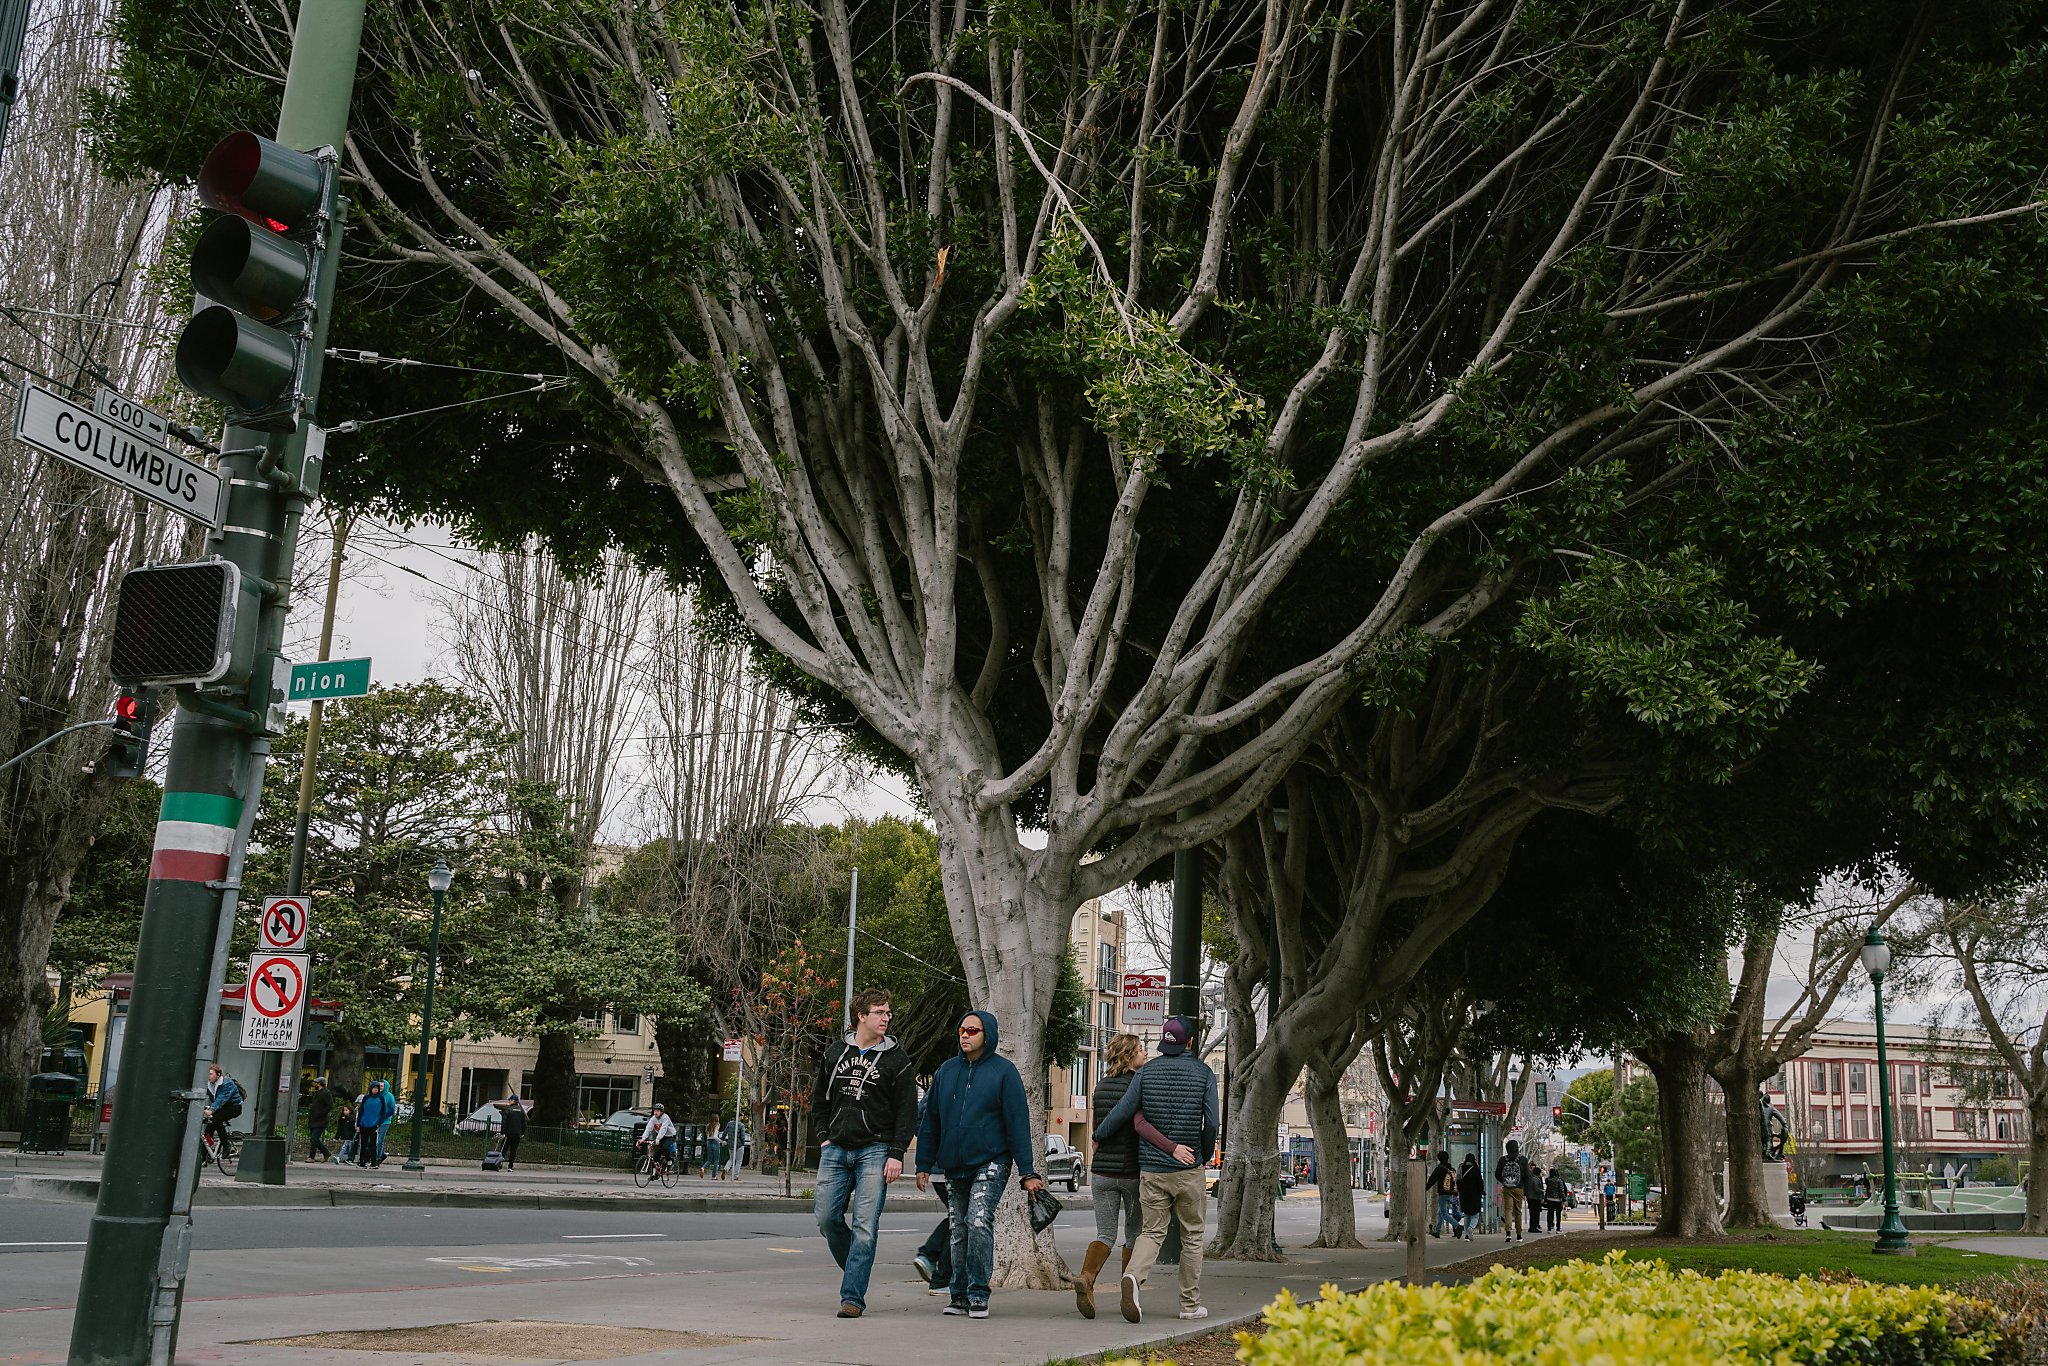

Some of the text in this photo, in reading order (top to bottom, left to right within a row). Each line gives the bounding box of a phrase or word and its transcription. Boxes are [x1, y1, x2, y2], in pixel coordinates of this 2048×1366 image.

[108, 398, 144, 429] 600
[55, 411, 198, 503] COLUMBUS
[295, 671, 346, 692] nion
[1125, 989, 1164, 998] NO STOPPING
[1127, 1001, 1160, 1011] ANY TIME
[250, 1017, 293, 1029] 7AM-9AM
[248, 1029, 293, 1041] 4PM-6PM
[837, 1056, 881, 1080] SAN FRANCCO
